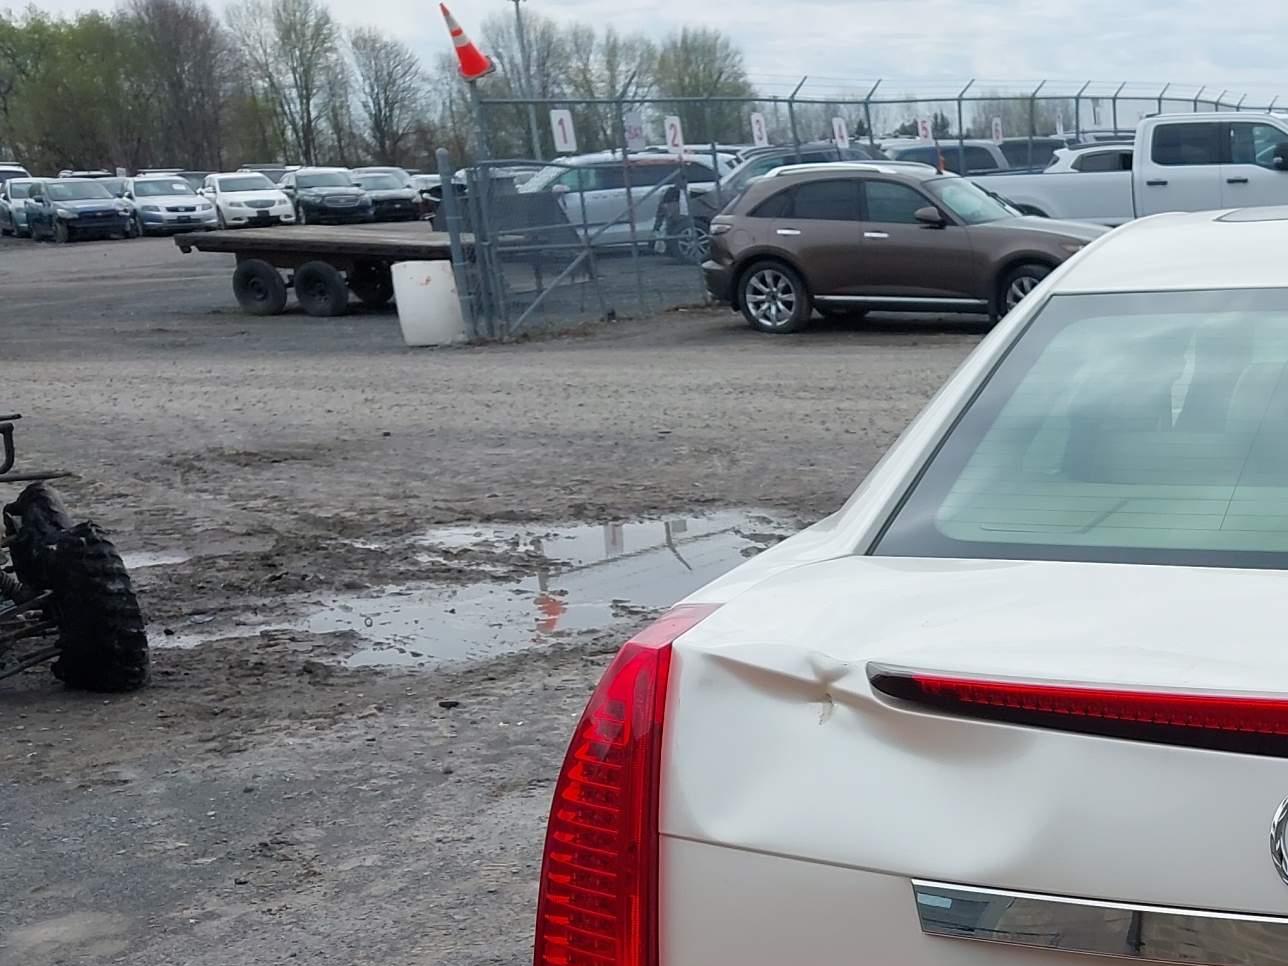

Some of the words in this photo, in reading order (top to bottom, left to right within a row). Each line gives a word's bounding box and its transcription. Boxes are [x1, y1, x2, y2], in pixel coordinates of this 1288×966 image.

[558, 117, 568, 145] 1
[668, 123, 680, 148] 2
[919, 119, 929, 139] 5
